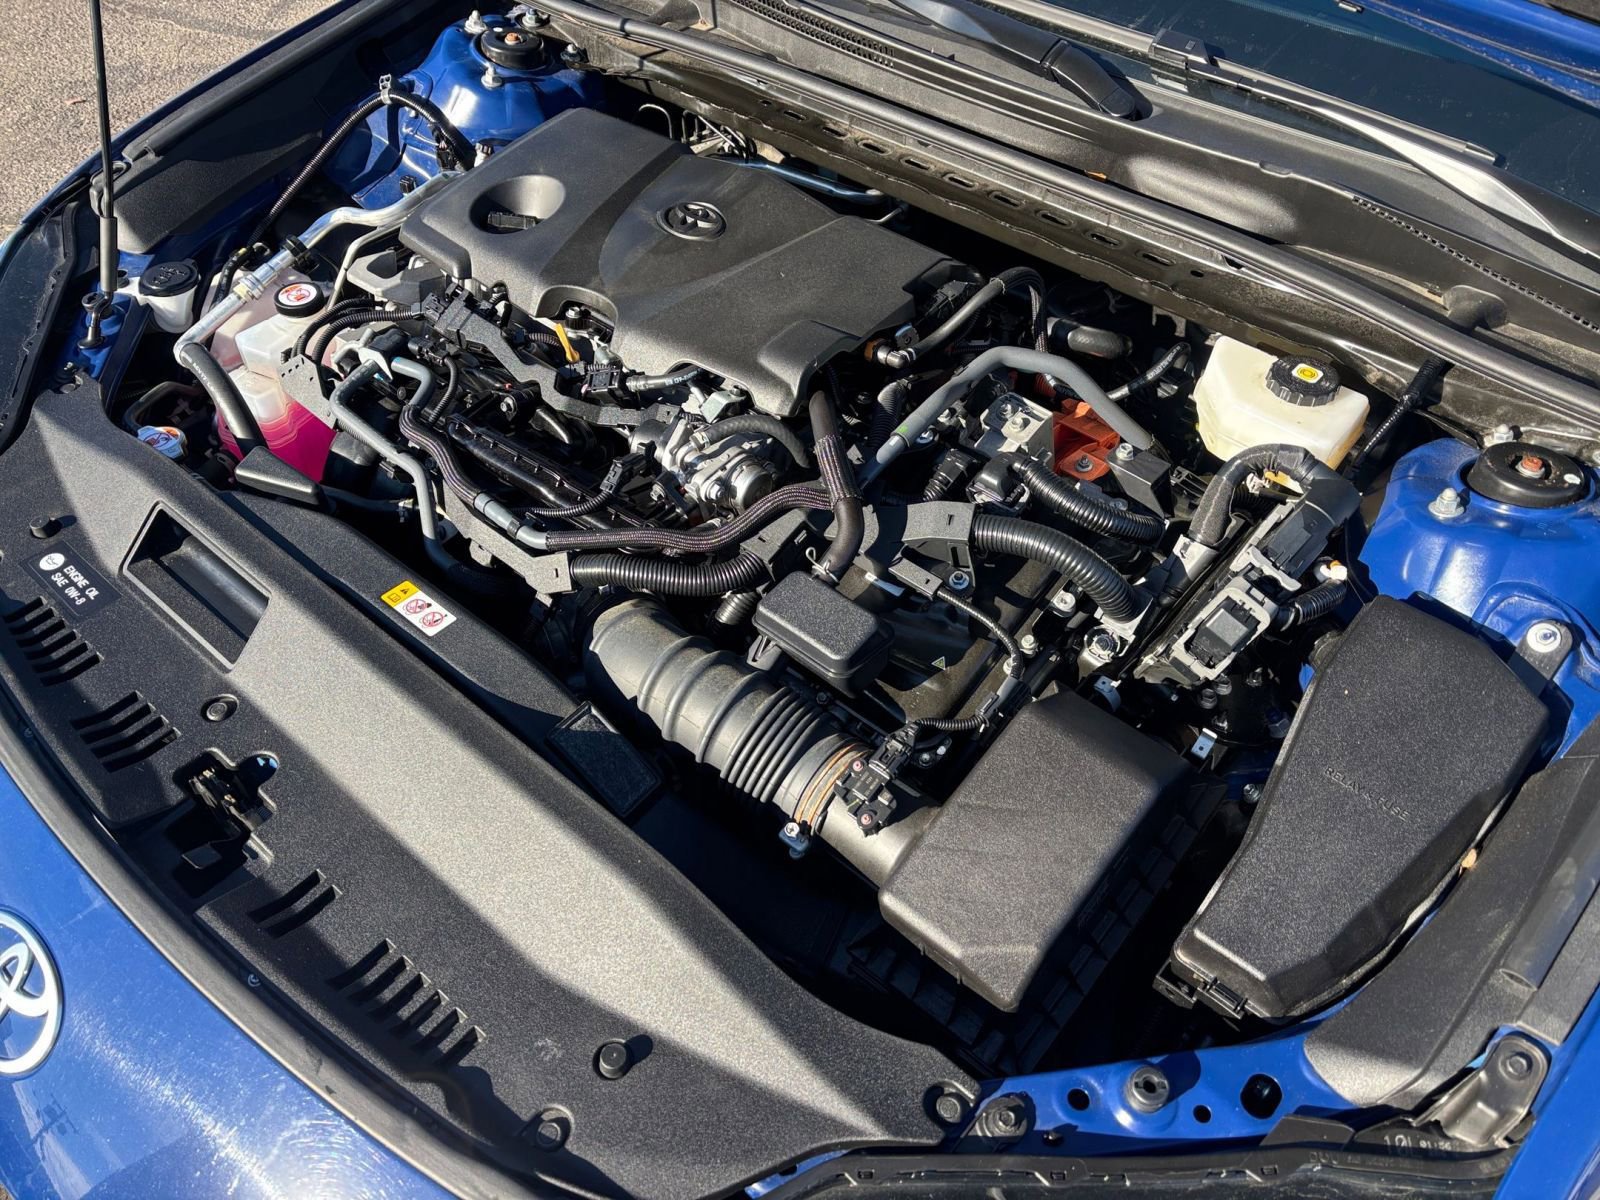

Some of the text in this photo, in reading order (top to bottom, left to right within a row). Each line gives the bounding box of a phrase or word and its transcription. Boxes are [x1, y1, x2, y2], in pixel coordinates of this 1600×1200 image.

[51, 572, 86, 605] SAE 0W-8
[63, 565, 99, 600] ENGINE OIL
[1324, 766, 1364, 794] RELAY
[1375, 797, 1410, 822] FUSE
